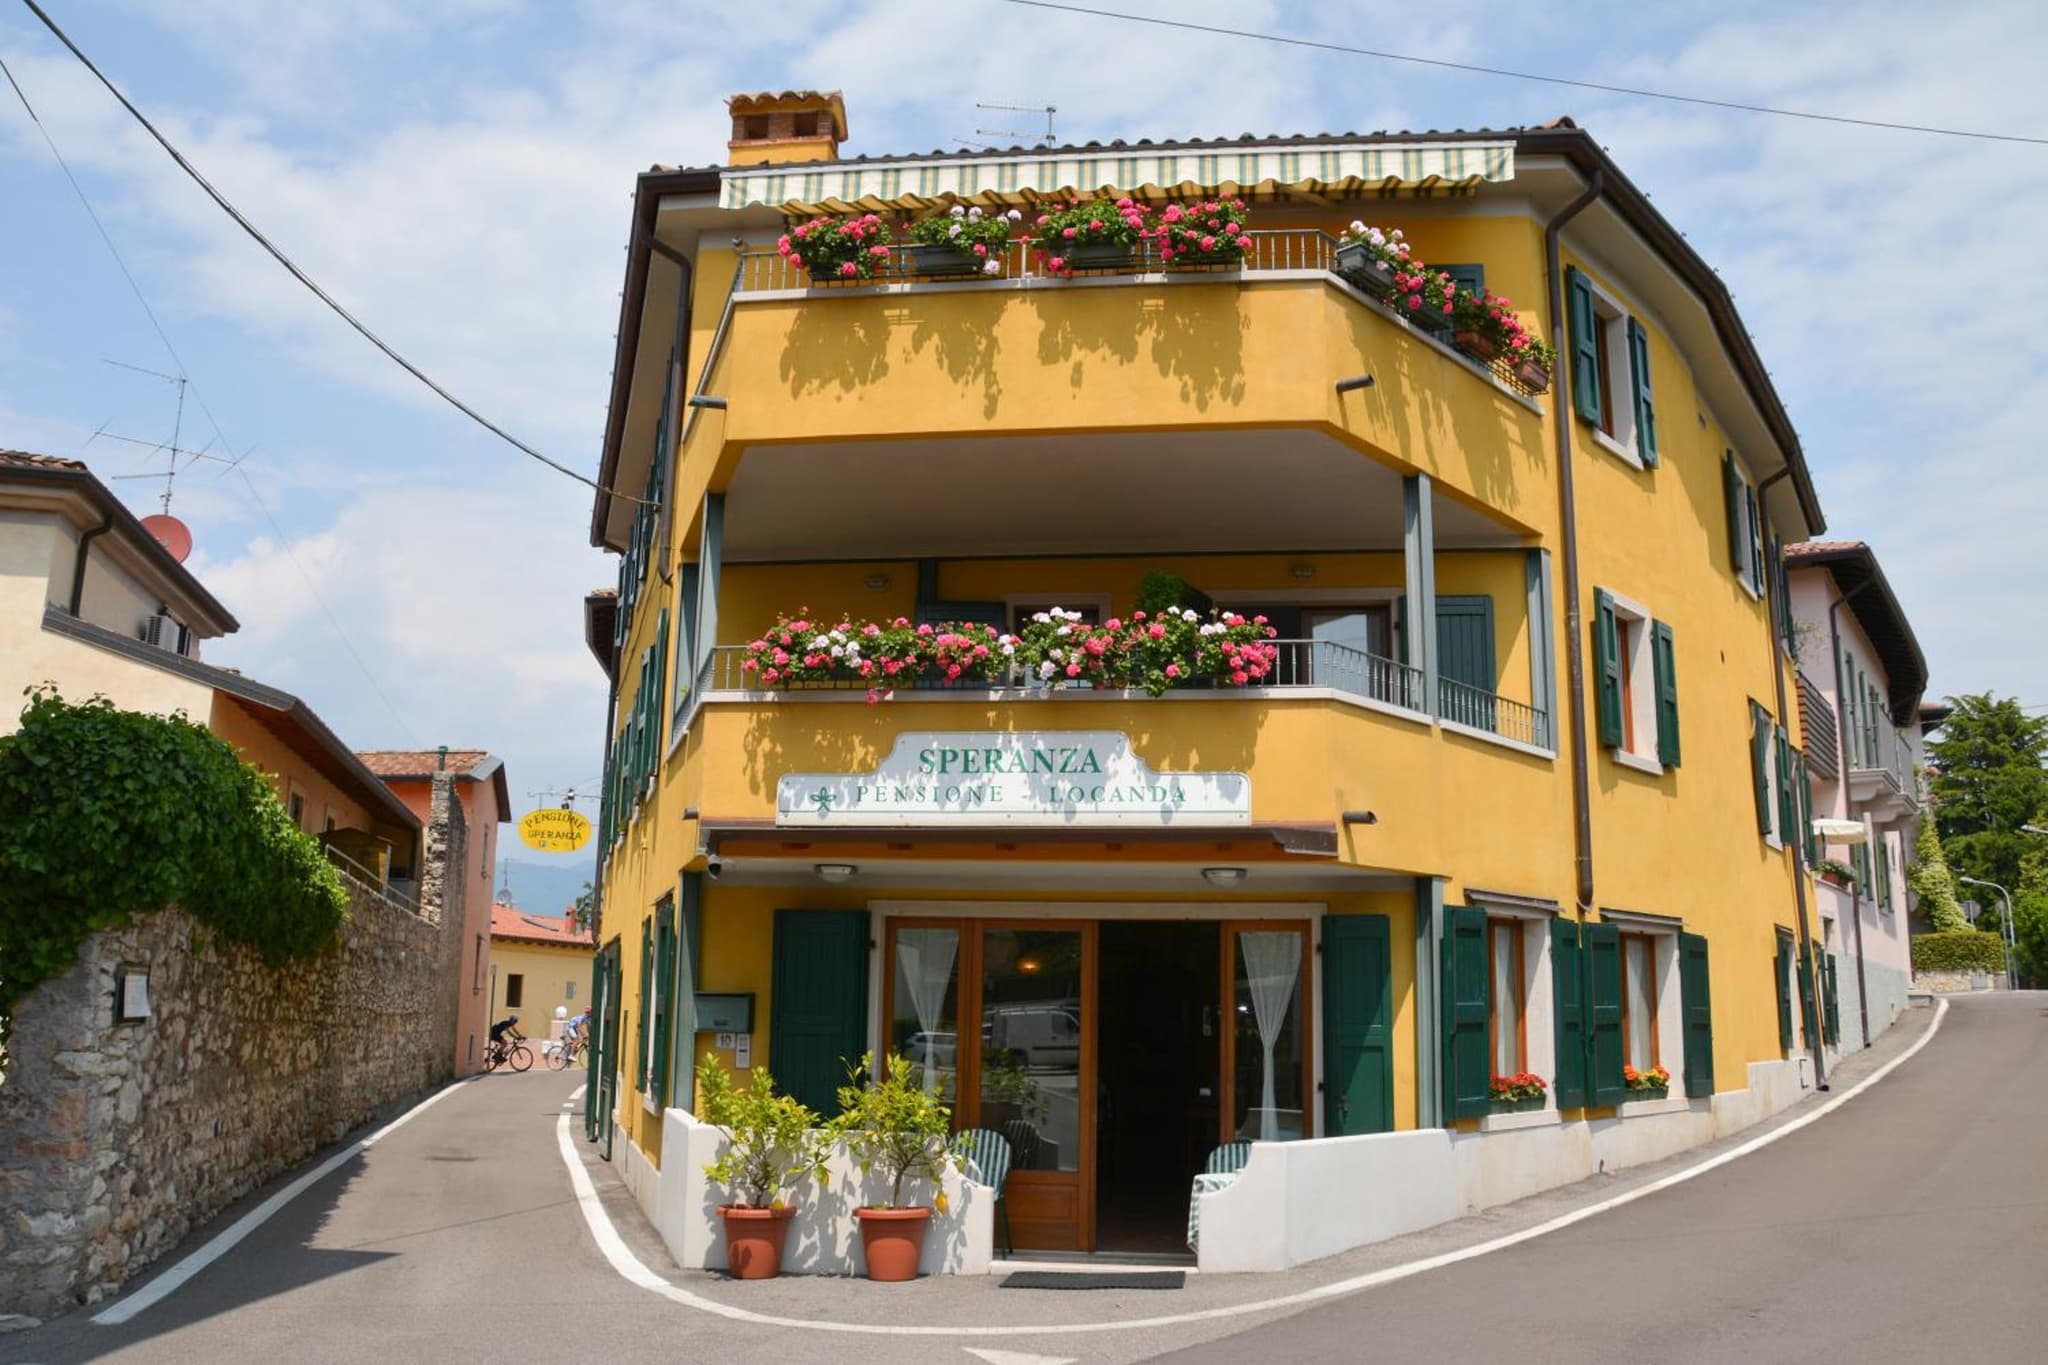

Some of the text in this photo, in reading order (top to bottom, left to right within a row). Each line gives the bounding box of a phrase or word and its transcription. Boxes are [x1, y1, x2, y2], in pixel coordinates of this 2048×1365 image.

[919, 748, 1102, 774] SPERANZA
[857, 785, 1187, 803] PENSIONE LOCANDA
[525, 812, 585, 829] PENSIONE
